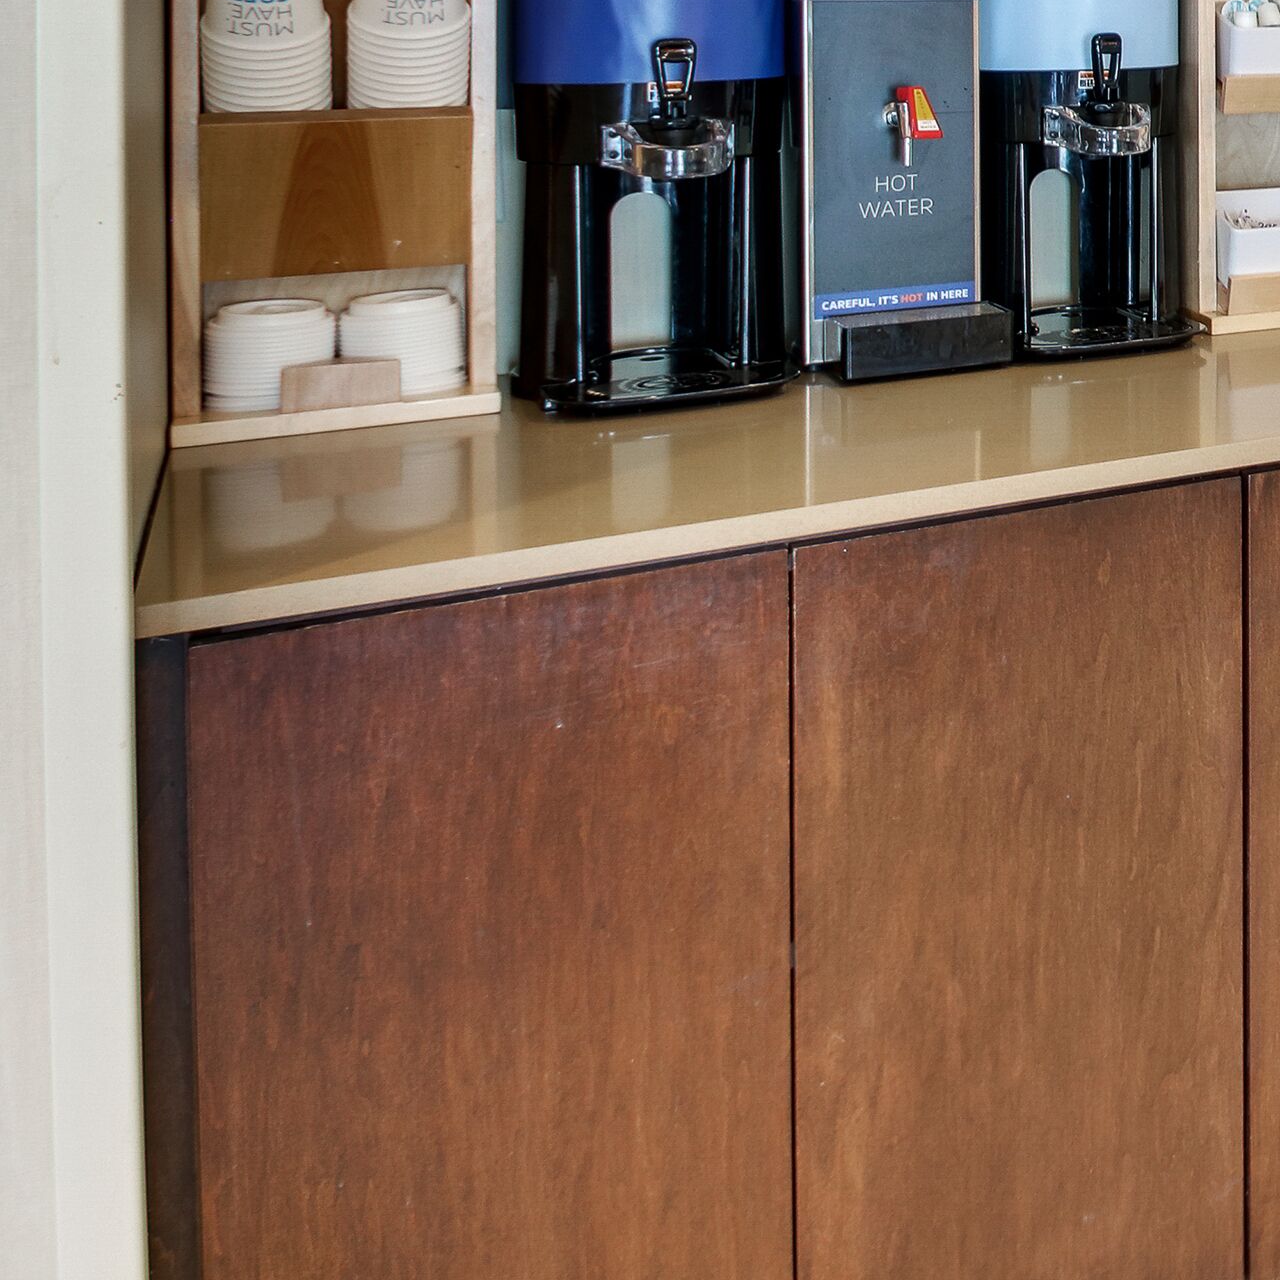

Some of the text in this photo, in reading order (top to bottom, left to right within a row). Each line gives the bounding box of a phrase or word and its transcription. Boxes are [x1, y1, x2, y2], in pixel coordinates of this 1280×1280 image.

[875, 174, 918, 192] HOT
[859, 198, 934, 218] WATER
[821, 288, 969, 311] CAREFUL, IT'S HOT IN HERE
